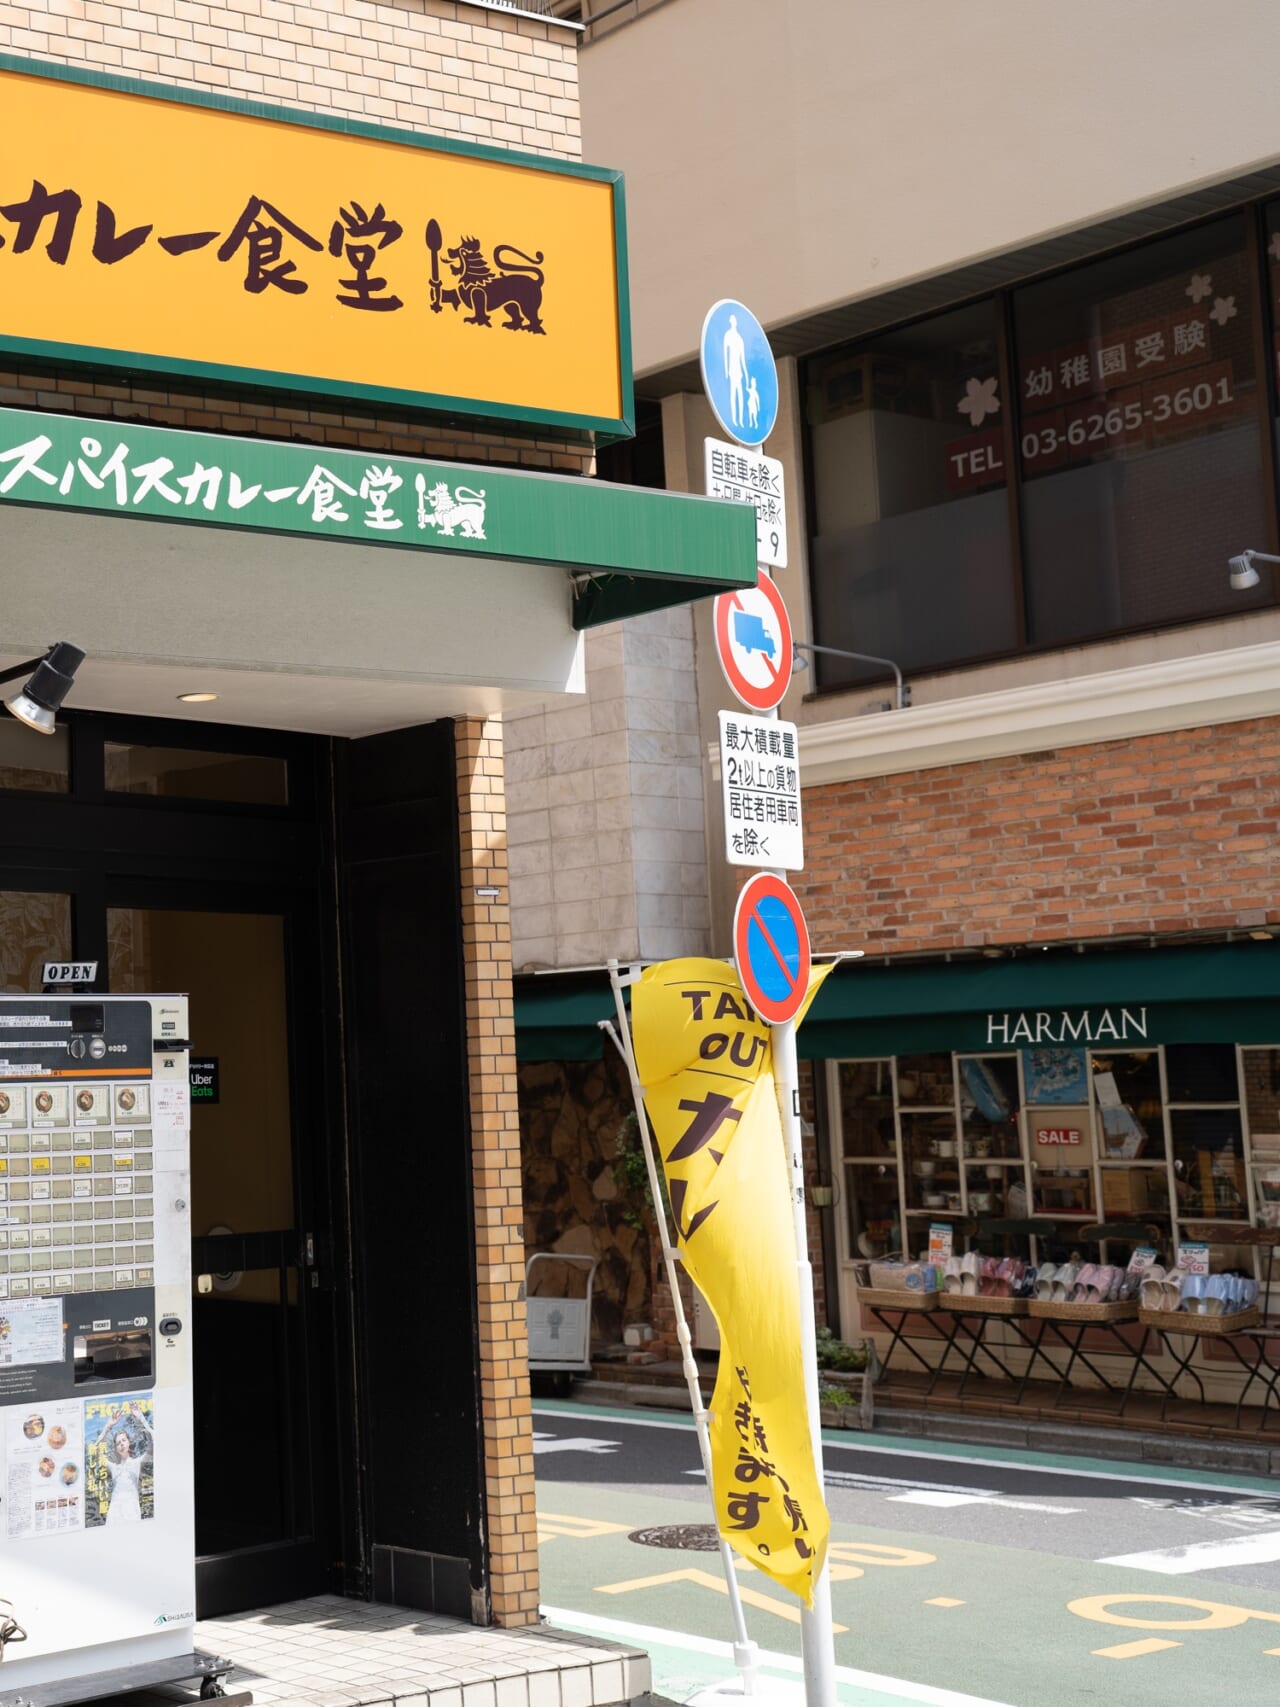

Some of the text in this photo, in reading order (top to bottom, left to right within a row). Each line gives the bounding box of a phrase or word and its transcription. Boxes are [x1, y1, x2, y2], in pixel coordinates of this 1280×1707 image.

[1024, 318, 1207, 400] 幼稚園受験
[951, 376, 1234, 480] TEL 03-6265-3601
[711, 448, 780, 494] 自転車を除く
[725, 722, 796, 760] 最大積載量
[727, 756, 797, 793] 2t以上の貨物
[729, 791, 799, 827] 居住者用車両
[731, 827, 771, 857] を除く
[48, 964, 93, 980] OPEN
[986, 1006, 1149, 1044] HARMAN
[191, 1074, 213, 1085] Uber
[191, 1086, 213, 1097] Eats
[1038, 1130, 1081, 1145] SALE
